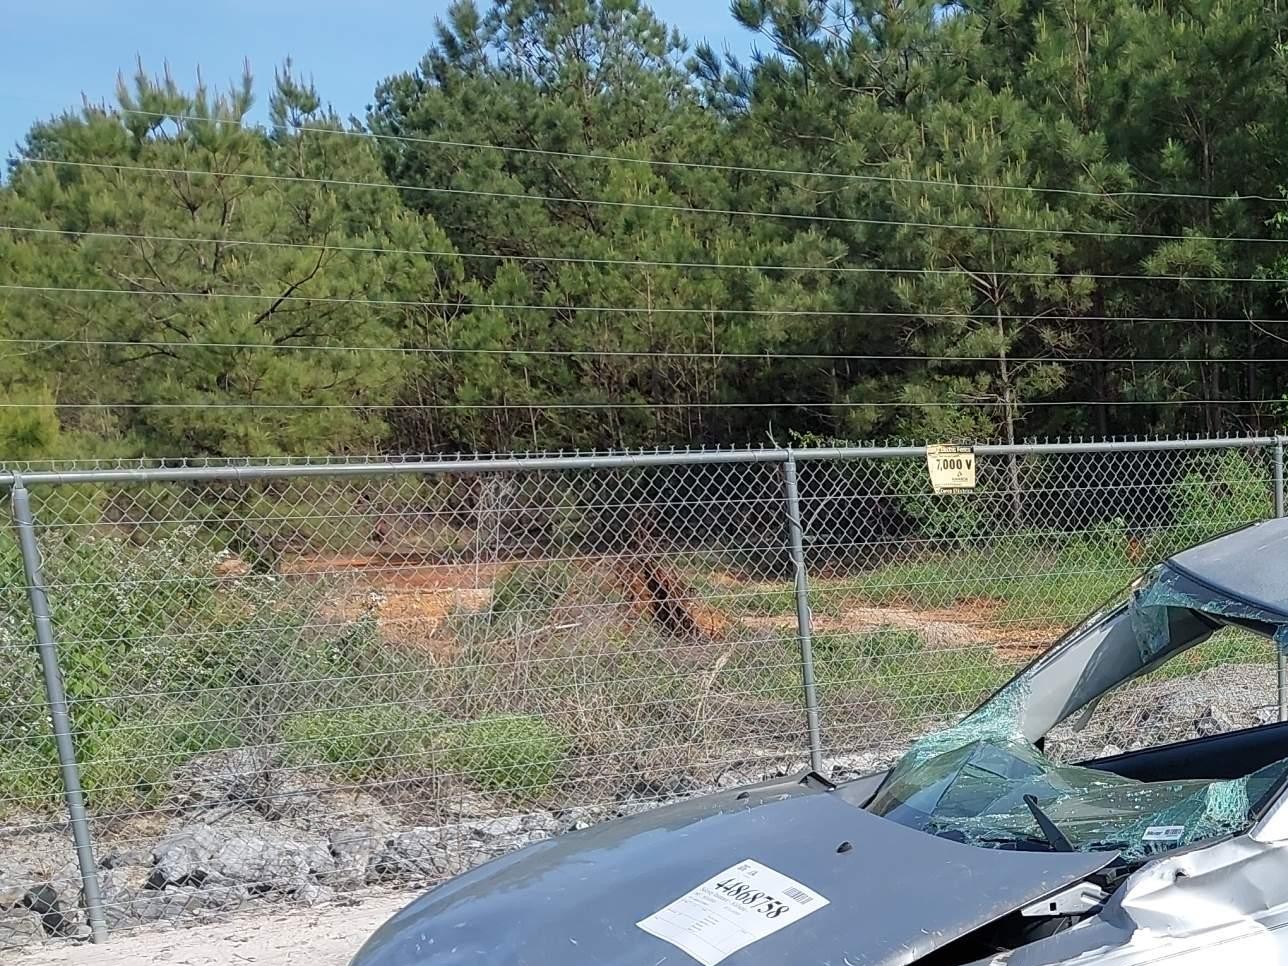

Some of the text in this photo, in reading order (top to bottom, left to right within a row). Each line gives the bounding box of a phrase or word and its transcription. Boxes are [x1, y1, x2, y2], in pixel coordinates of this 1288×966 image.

[936, 458, 972, 472] 7,000 V
[715, 877, 790, 919] 44868758
